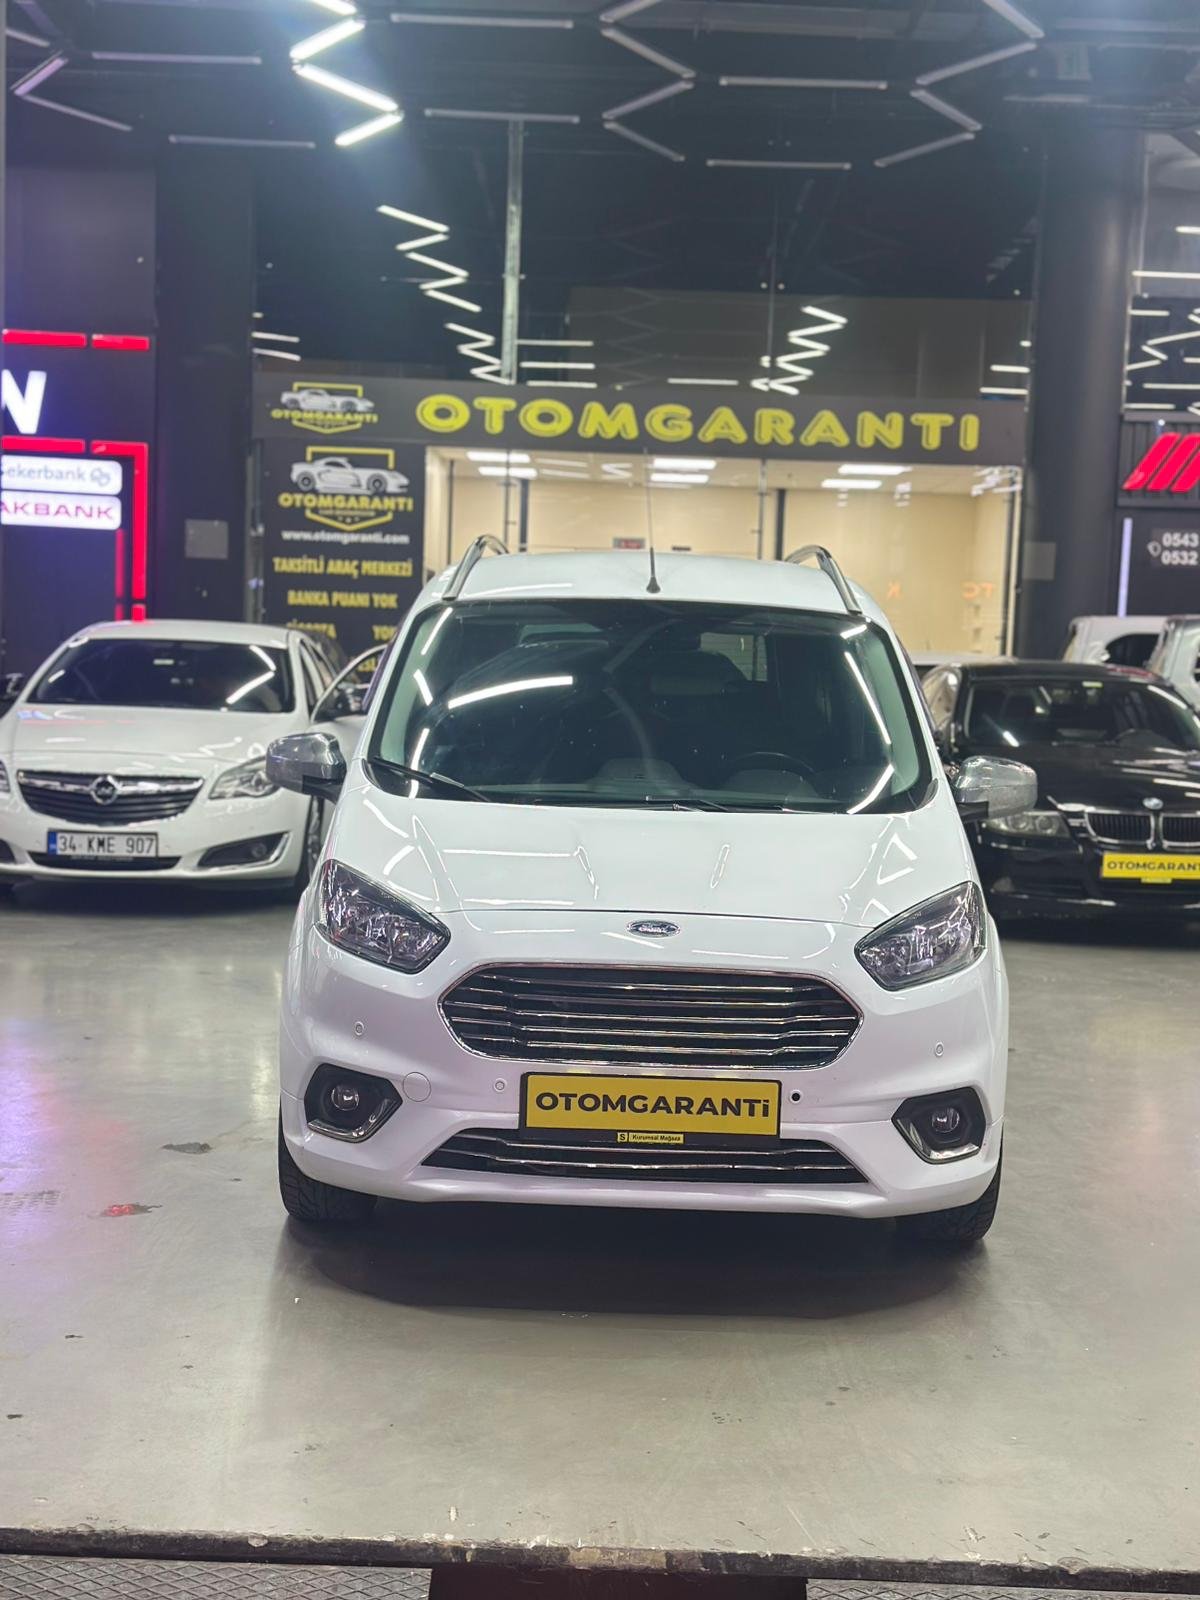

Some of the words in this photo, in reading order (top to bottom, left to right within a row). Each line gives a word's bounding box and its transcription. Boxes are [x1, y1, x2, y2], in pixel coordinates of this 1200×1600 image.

[271, 408, 378, 423] OTOMGARANTI
[415, 394, 980, 451] OTOMGARANTI
[278, 492, 414, 512] OTOMGARANTI
[1162, 532, 1199, 547] 0543
[1161, 550, 1198, 565] 0532
[58, 836, 76, 852] 34
[87, 836, 116, 853] KME
[126, 837, 154, 854] 907
[632, 1133, 659, 1141] Kurumsal
